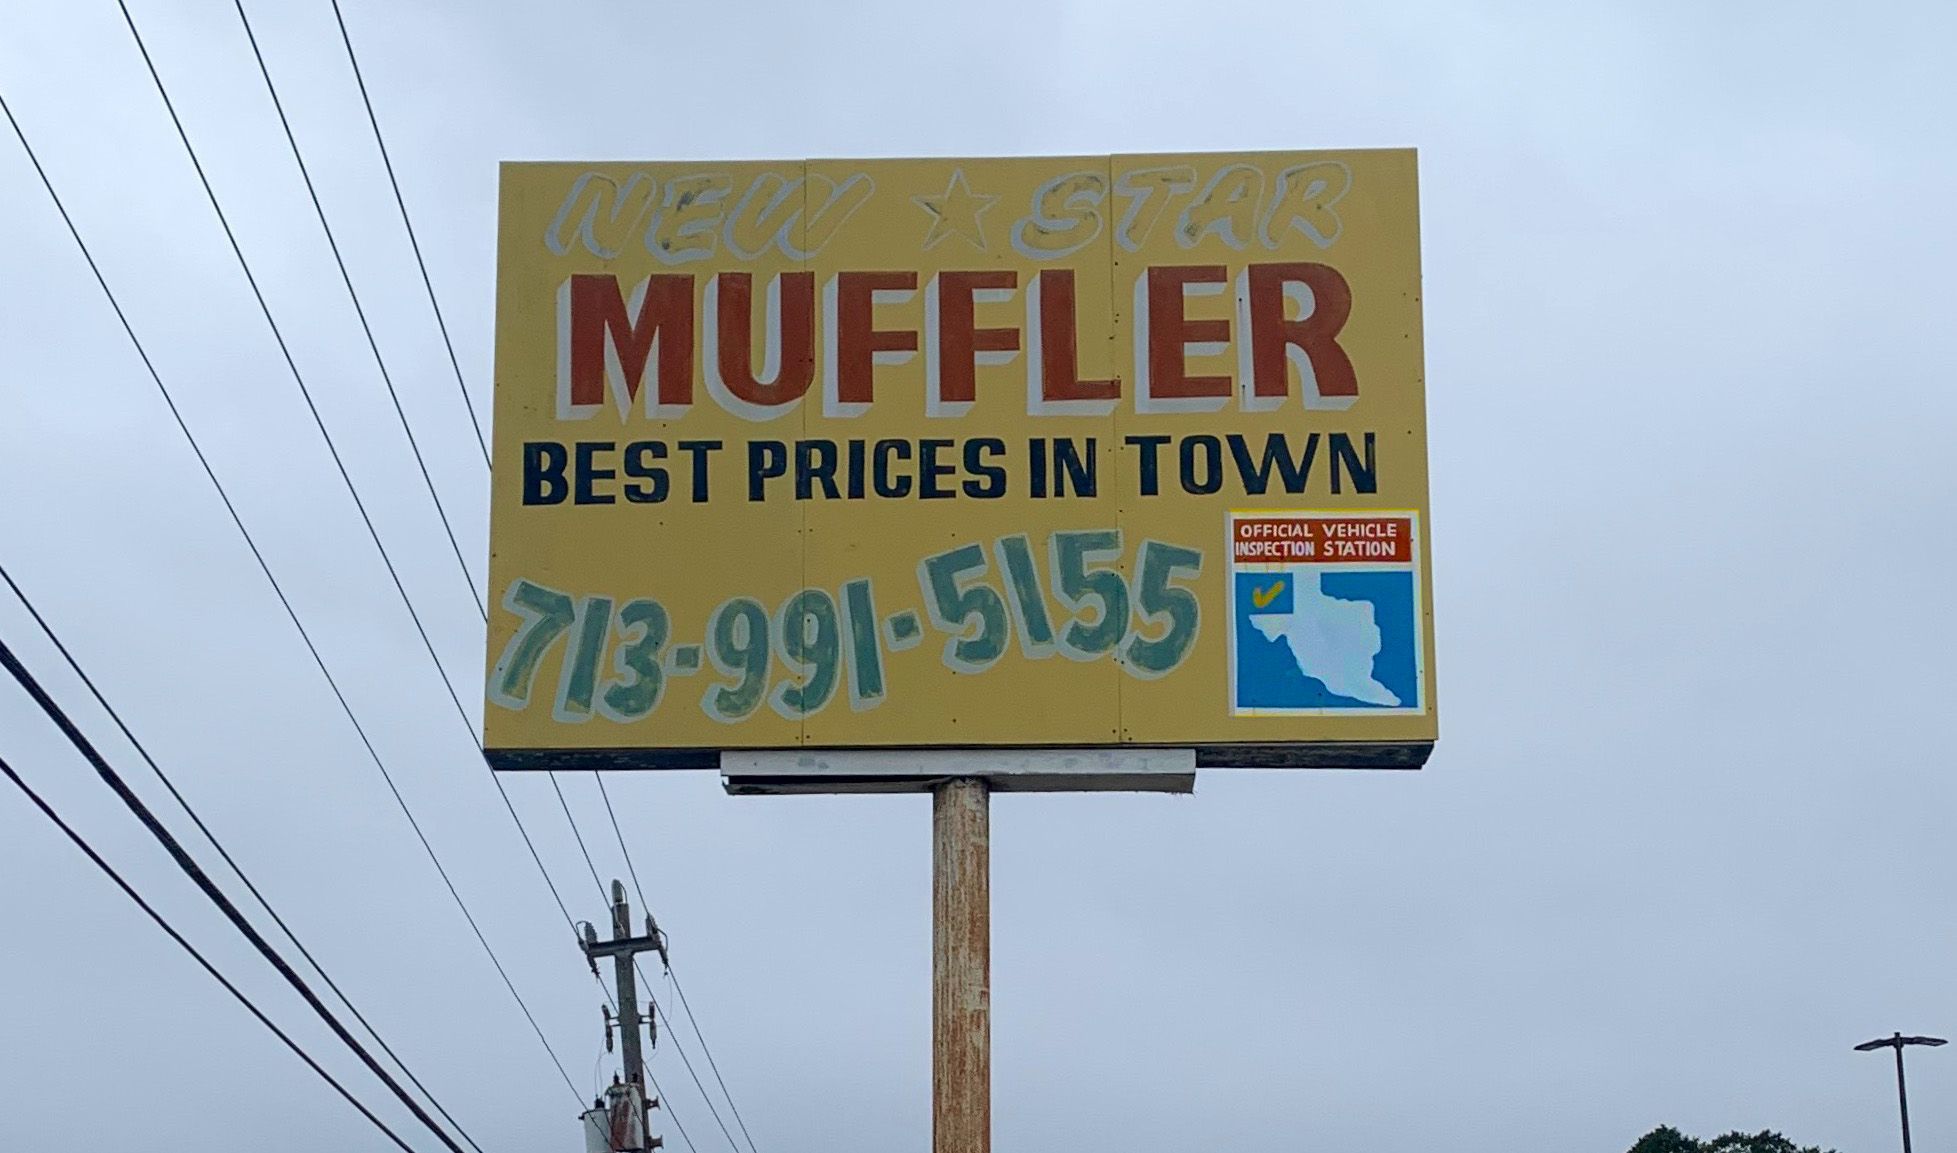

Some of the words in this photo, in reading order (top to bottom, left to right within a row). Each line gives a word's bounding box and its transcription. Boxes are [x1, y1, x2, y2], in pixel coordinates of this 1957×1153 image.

[544, 171, 876, 266] NEW
[1010, 160, 1353, 260] STAR
[556, 262, 1360, 425] MUFFLER
[522, 440, 723, 506] BEST
[747, 438, 1007, 502] PRICES
[1028, 437, 1098, 499] IN
[1124, 432, 1378, 496] TOWN
[1235, 540, 1316, 556] INSPECTION
[1323, 540, 1396, 556] STATION
[1240, 523, 1314, 538] OFFICIAL
[1322, 522, 1398, 538] VEHICLE
